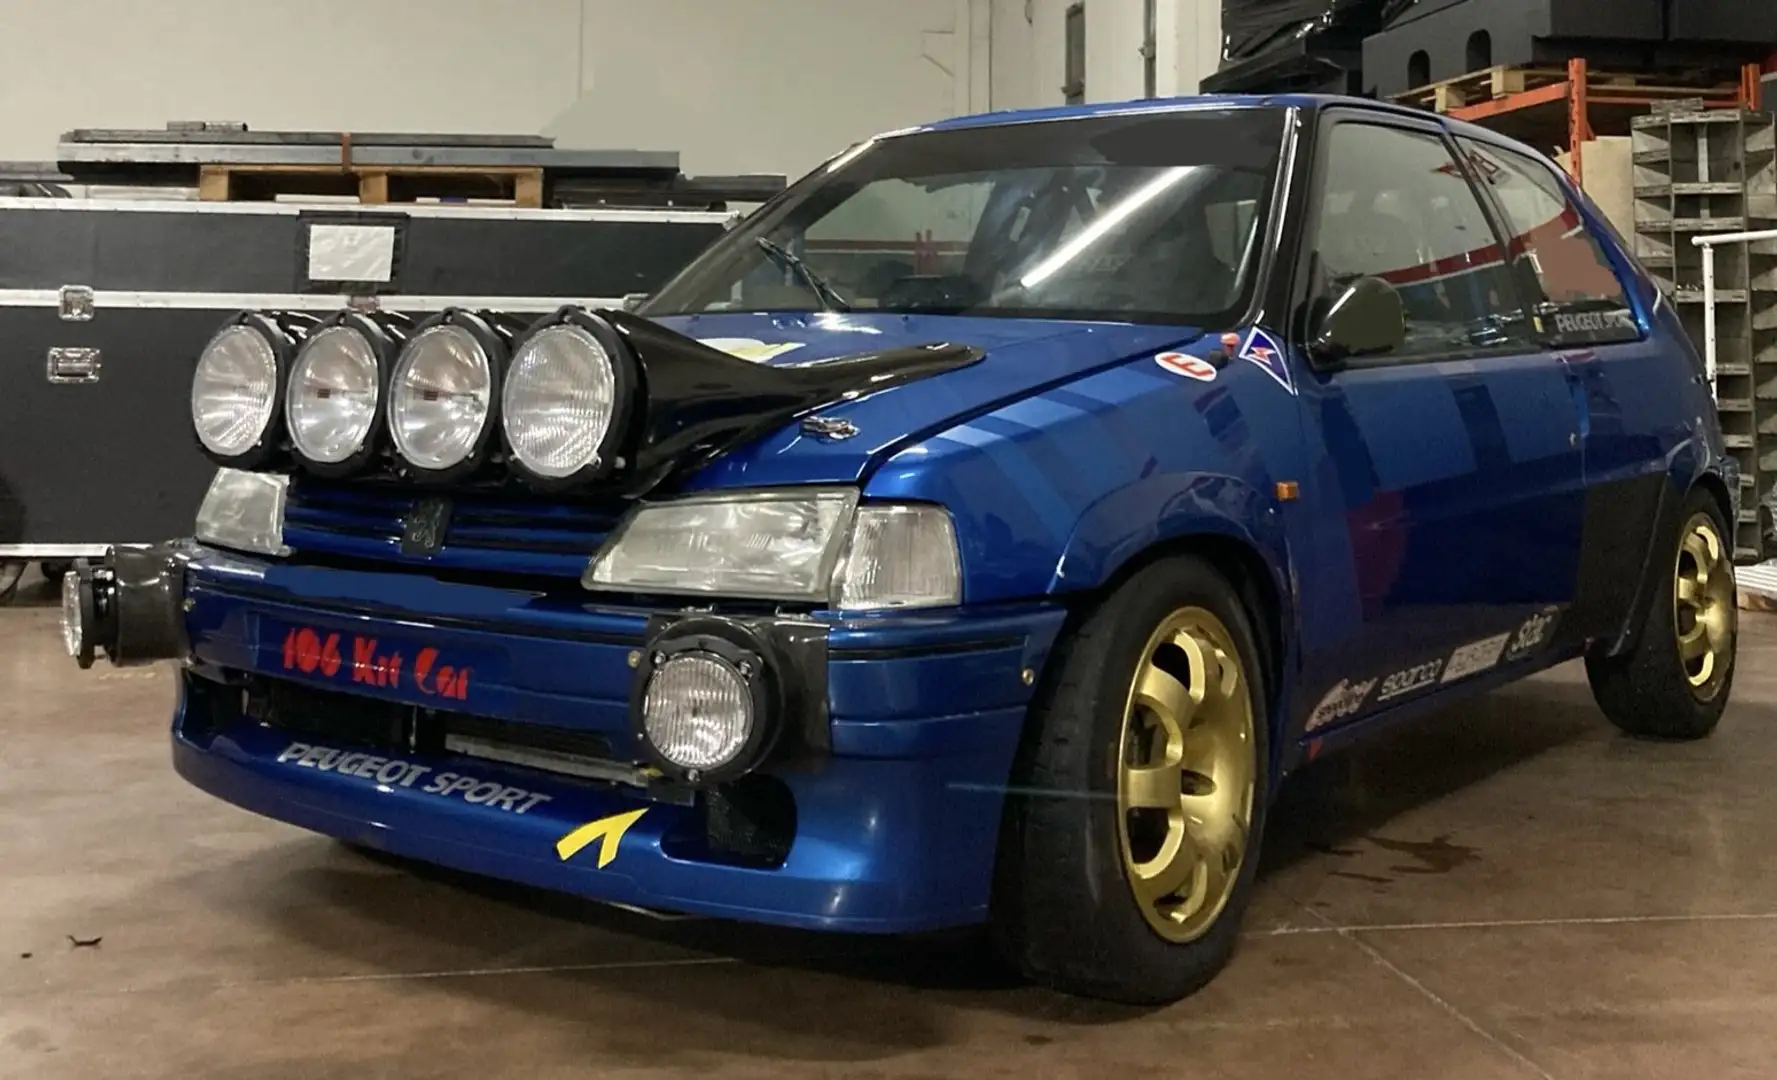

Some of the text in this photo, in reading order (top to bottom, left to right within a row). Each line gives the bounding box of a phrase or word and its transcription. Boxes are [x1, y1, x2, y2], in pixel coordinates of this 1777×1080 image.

[282, 627, 471, 701] 106 Kit Car
[276, 741, 552, 815] PEUGEOT SPORT
